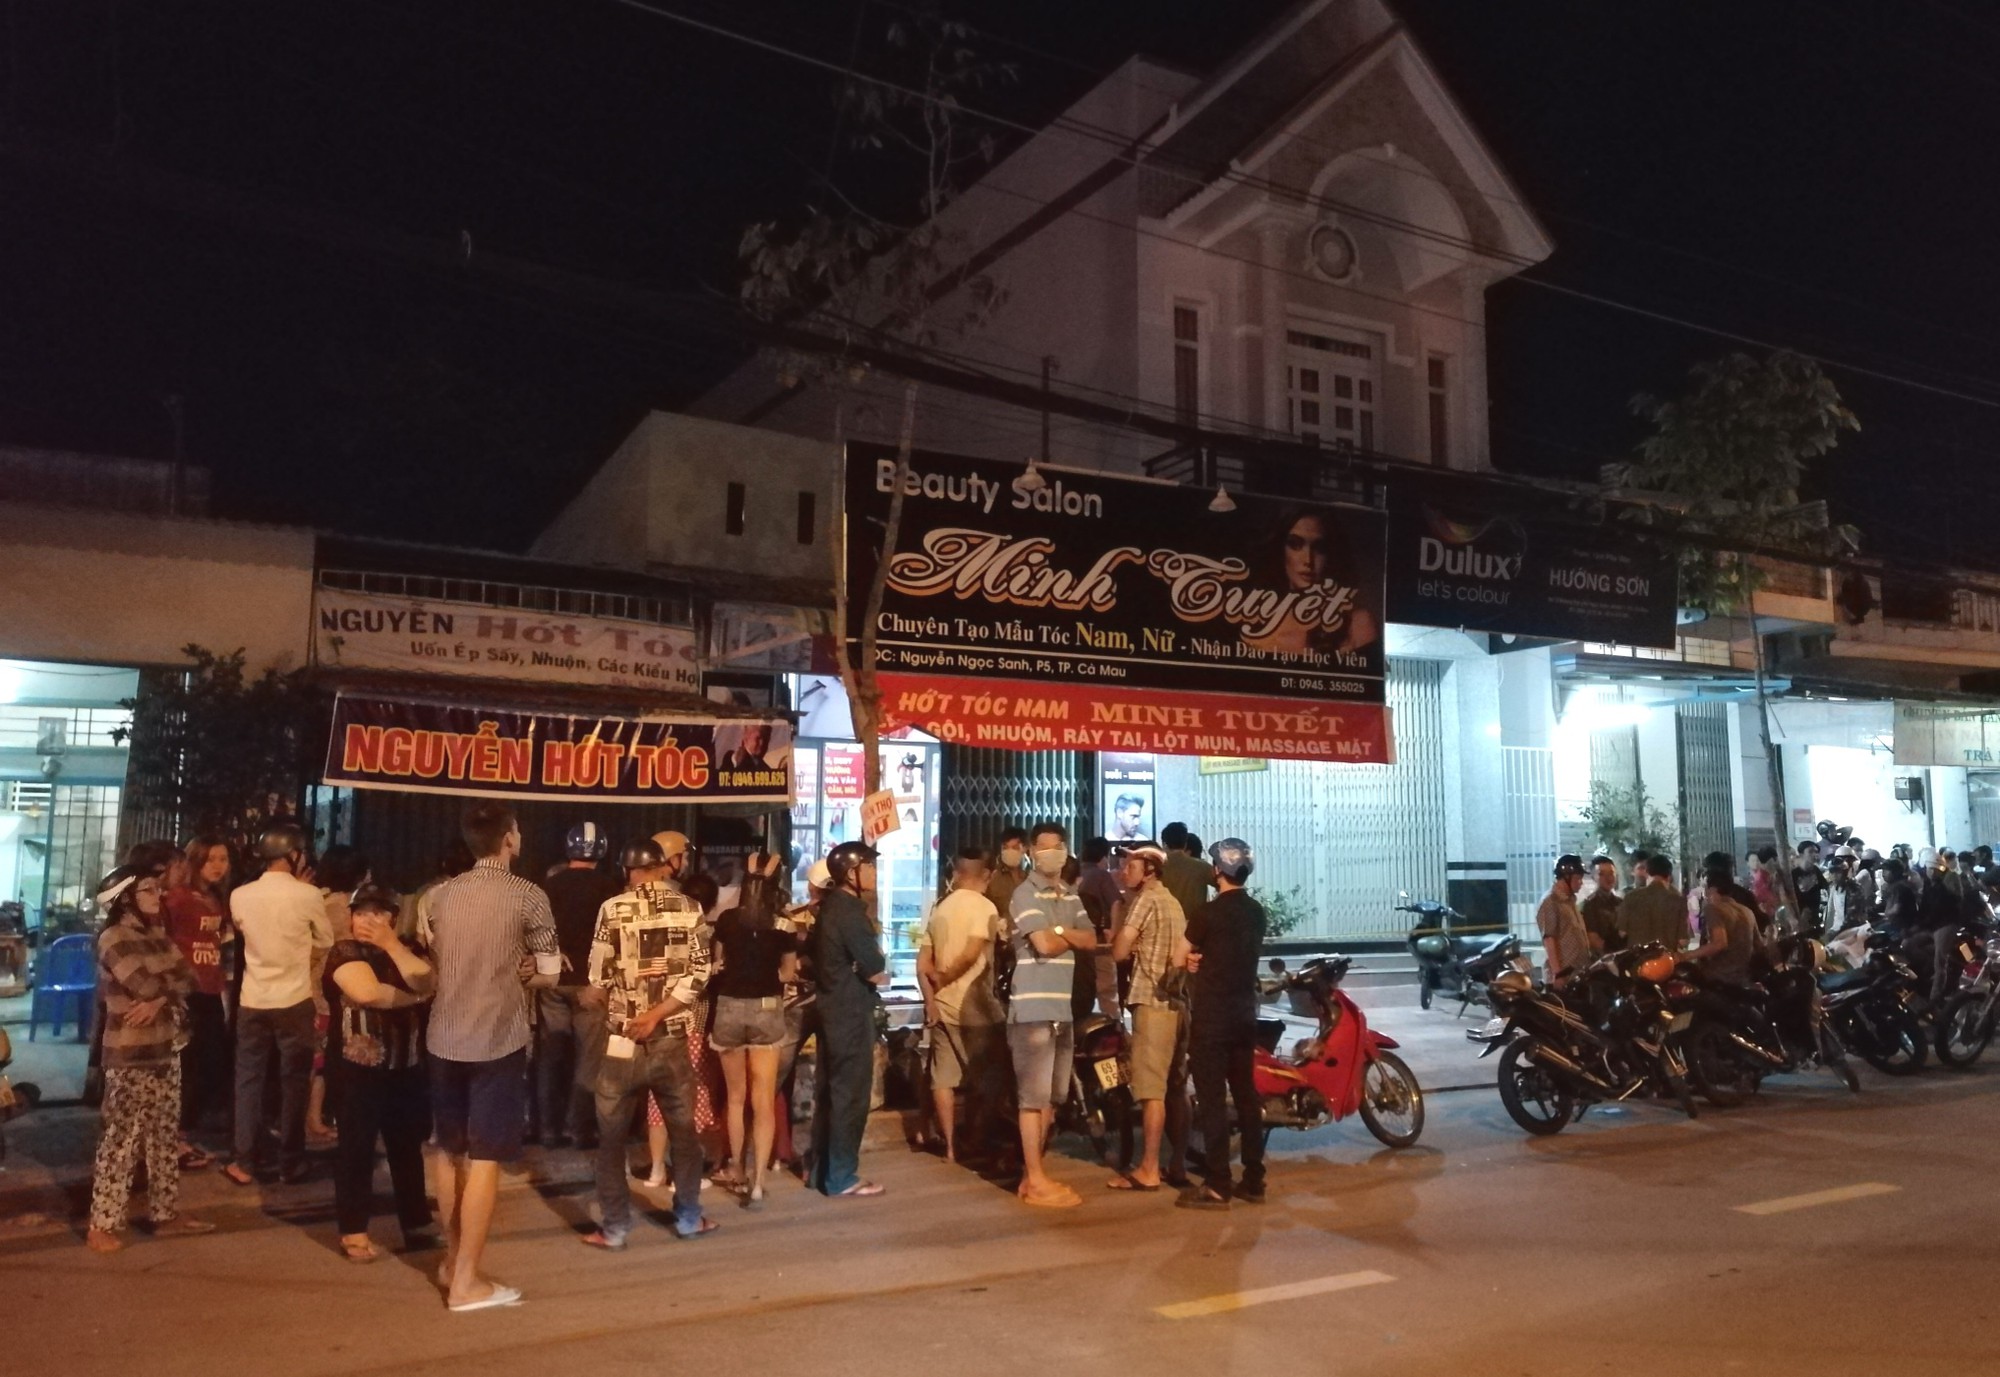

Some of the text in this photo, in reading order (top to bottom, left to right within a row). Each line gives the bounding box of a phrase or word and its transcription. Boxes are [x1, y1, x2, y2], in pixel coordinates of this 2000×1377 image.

[876, 458, 1103, 519] Beauty Salon
[1418, 536, 1511, 581] Dulux
[886, 528, 1357, 638] Minh Tuyết
[1417, 577, 1510, 605] let's colour
[1615, 575, 1650, 596] SƠN
[454, 641, 480, 662] Ép
[597, 657, 628, 674] Các
[634, 661, 670, 680] Kiểu
[877, 612, 949, 638] Chuyên
[954, 618, 989, 641] Tạo
[994, 619, 1034, 642] Mẫu
[1038, 623, 1071, 645] Tóc
[1075, 621, 1136, 653] Nam,
[1142, 626, 1176, 653] Nữ
[1191, 637, 1231, 659] Nhận
[1303, 650, 1330, 668] Học
[1335, 649, 1367, 668] Viên
[900, 650, 954, 668] Nguyễn
[958, 654, 994, 670] Ngọc
[998, 657, 1032, 672] Sanh,
[1036, 660, 1054, 674] P5,
[1058, 661, 1074, 674] TP.
[1077, 661, 1096, 675] Cà
[1100, 664, 1127, 677] Mau
[1299, 679, 1326, 691] 0945.
[1329, 681, 1365, 693] 355025
[899, 688, 1344, 735] HỚT TÓC NAM MINH TUYẾT
[342, 720, 709, 790] NGUYỄN HỚT TÓC
[976, 722, 1058, 746] NHUỘM,
[1063, 725, 1103, 746] RÁY
[1109, 729, 1147, 751] TAI,
[1153, 730, 1189, 752] LỘT
[1195, 735, 1241, 755] MỤN,
[1246, 737, 1331, 755] MASSAGE
[1336, 738, 1372, 759] MẶT
